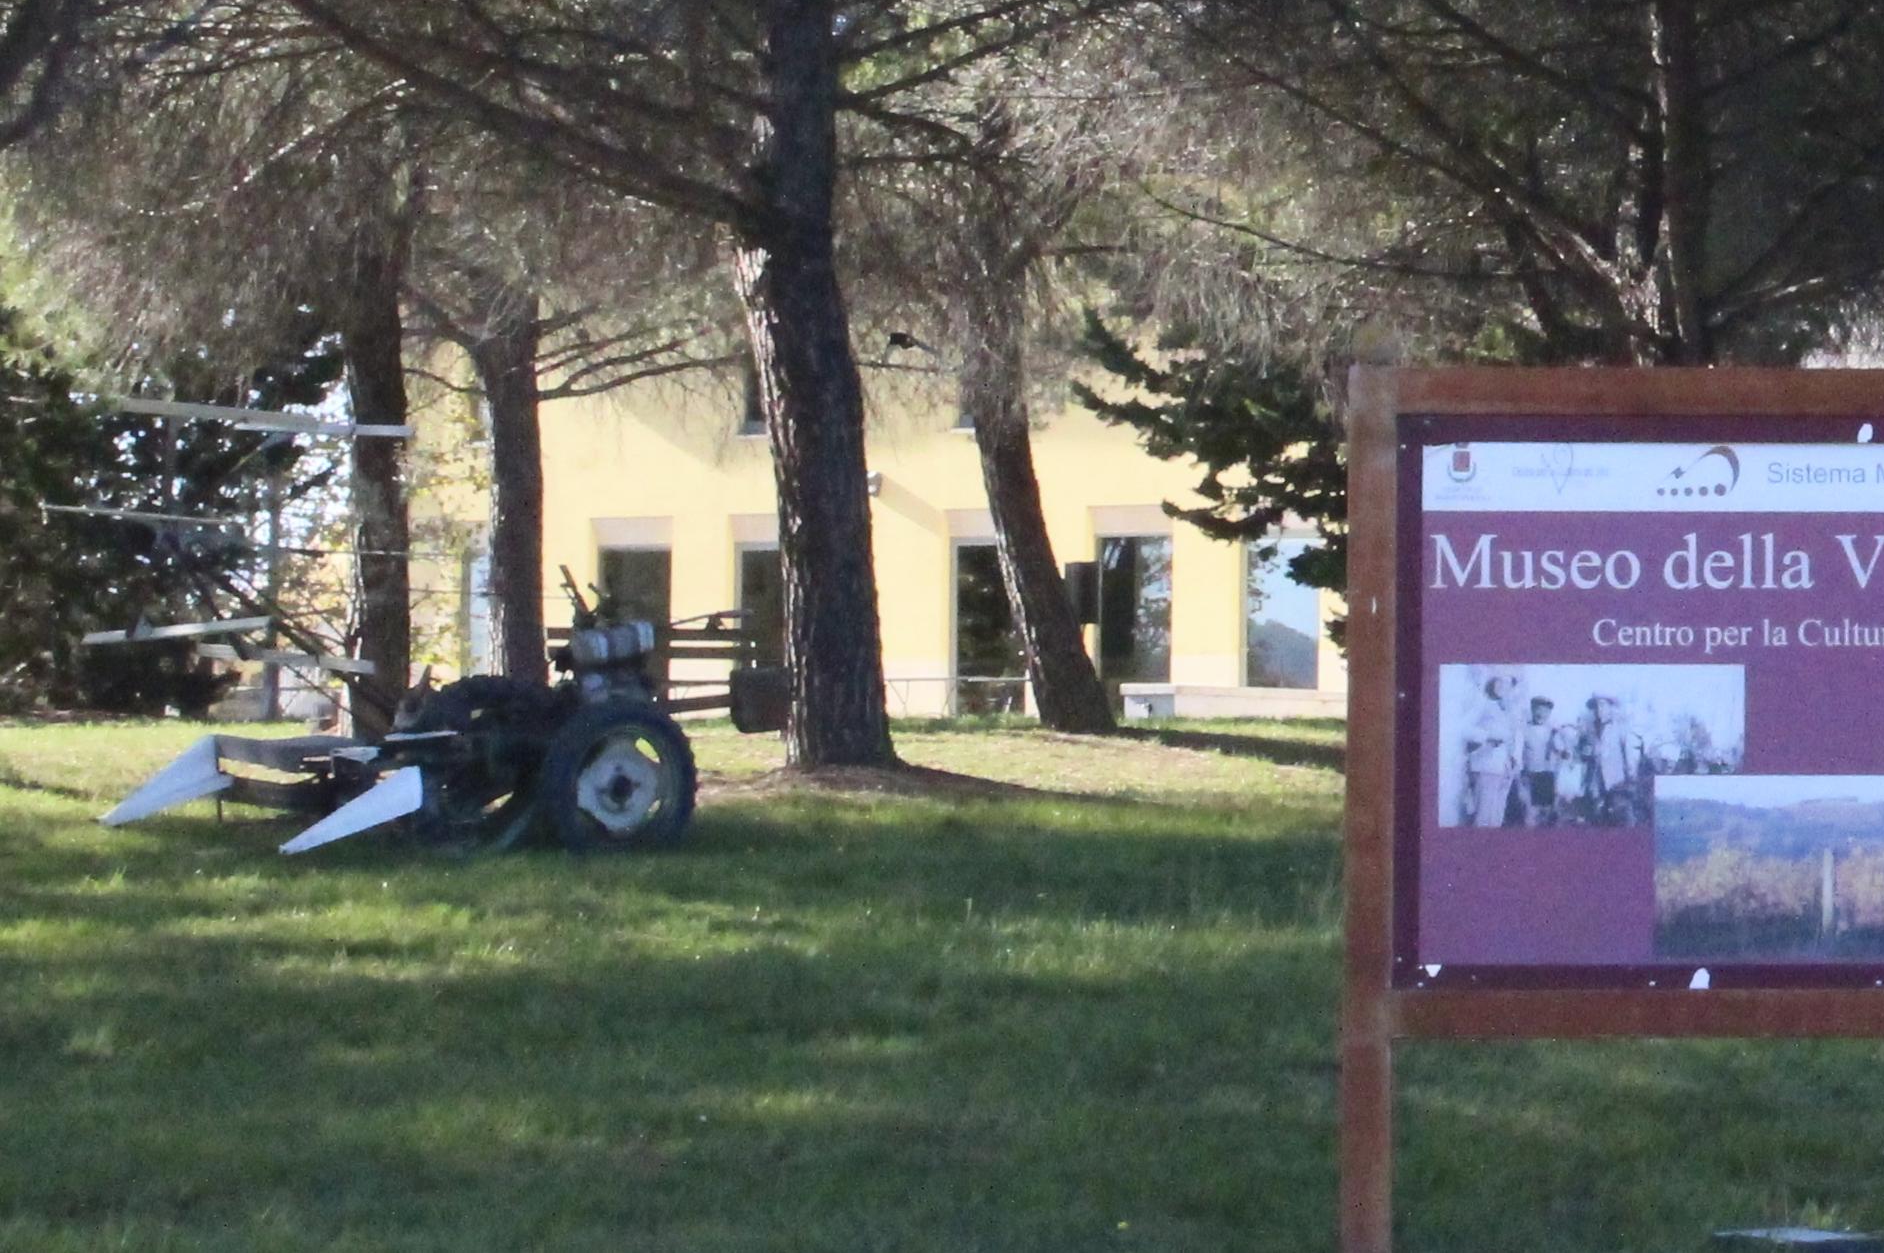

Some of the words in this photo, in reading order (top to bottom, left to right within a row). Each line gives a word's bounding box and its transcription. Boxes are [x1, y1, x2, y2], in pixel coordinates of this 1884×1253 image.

[1768, 463, 1867, 486] Sistema
[1430, 533, 1642, 591] Museo
[1664, 533, 1816, 591] della
[1593, 619, 1696, 648] Centro
[1705, 627, 1754, 656] per
[1764, 619, 1790, 648] la
